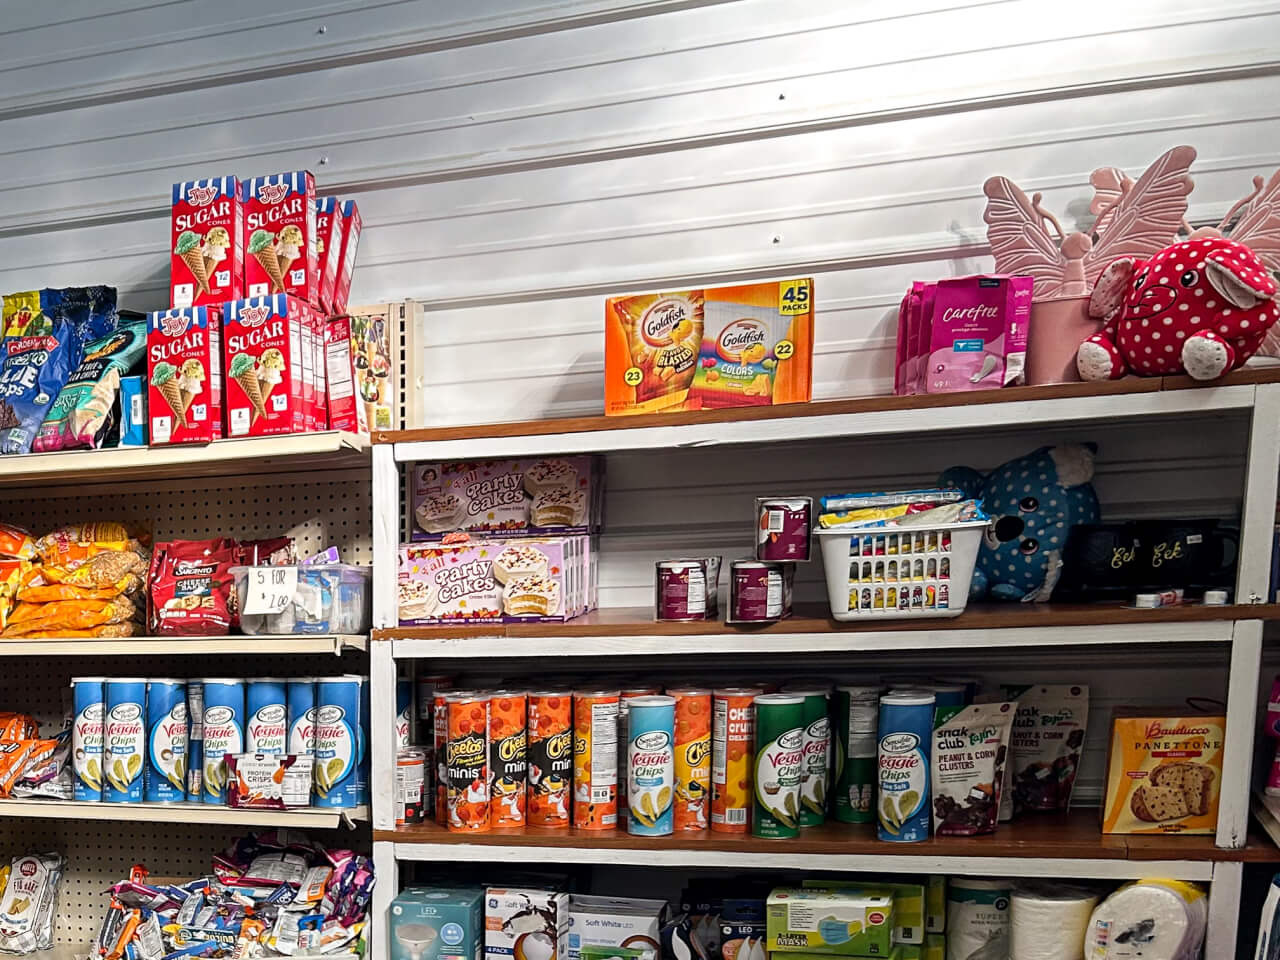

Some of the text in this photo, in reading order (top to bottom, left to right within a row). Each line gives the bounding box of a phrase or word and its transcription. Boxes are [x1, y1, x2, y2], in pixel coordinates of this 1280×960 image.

[188, 185, 217, 205] Joy
[258, 184, 288, 204] Joy
[175, 202, 231, 233] SUGAR
[247, 198, 303, 231] SUGAR
[782, 285, 809, 303] 45
[782, 302, 808, 312] PACKS
[942, 304, 999, 325] Carefree
[240, 306, 269, 327] Joy
[647, 307, 686, 337] Goldfish
[161, 316, 190, 337] Joy
[228, 321, 284, 354] SUGAR
[722, 331, 765, 348] Goldfish
[150, 331, 205, 363] SUGAR
[776, 344, 791, 355] 22
[657, 349, 692, 368] BLASTED
[627, 371, 640, 382] 23
[465, 472, 523, 500] Party
[271, 569, 286, 585] FOR
[435, 558, 492, 585] Party
[104, 721, 142, 738] Veggie
[936, 725, 969, 739] snak
[111, 735, 137, 747] Chips
[256, 737, 282, 749] Chips
[937, 738, 965, 750] club
[1134, 740, 1222, 750] PANETTONE
[632, 751, 671, 767] Veggie
[938, 750, 996, 764] PEANUT CORN
[634, 766, 665, 778] Chips
[938, 761, 975, 772] CLUSTERS
[880, 769, 911, 782] Chips
[738, 926, 753, 934] LED
[776, 937, 809, 948] MASK
